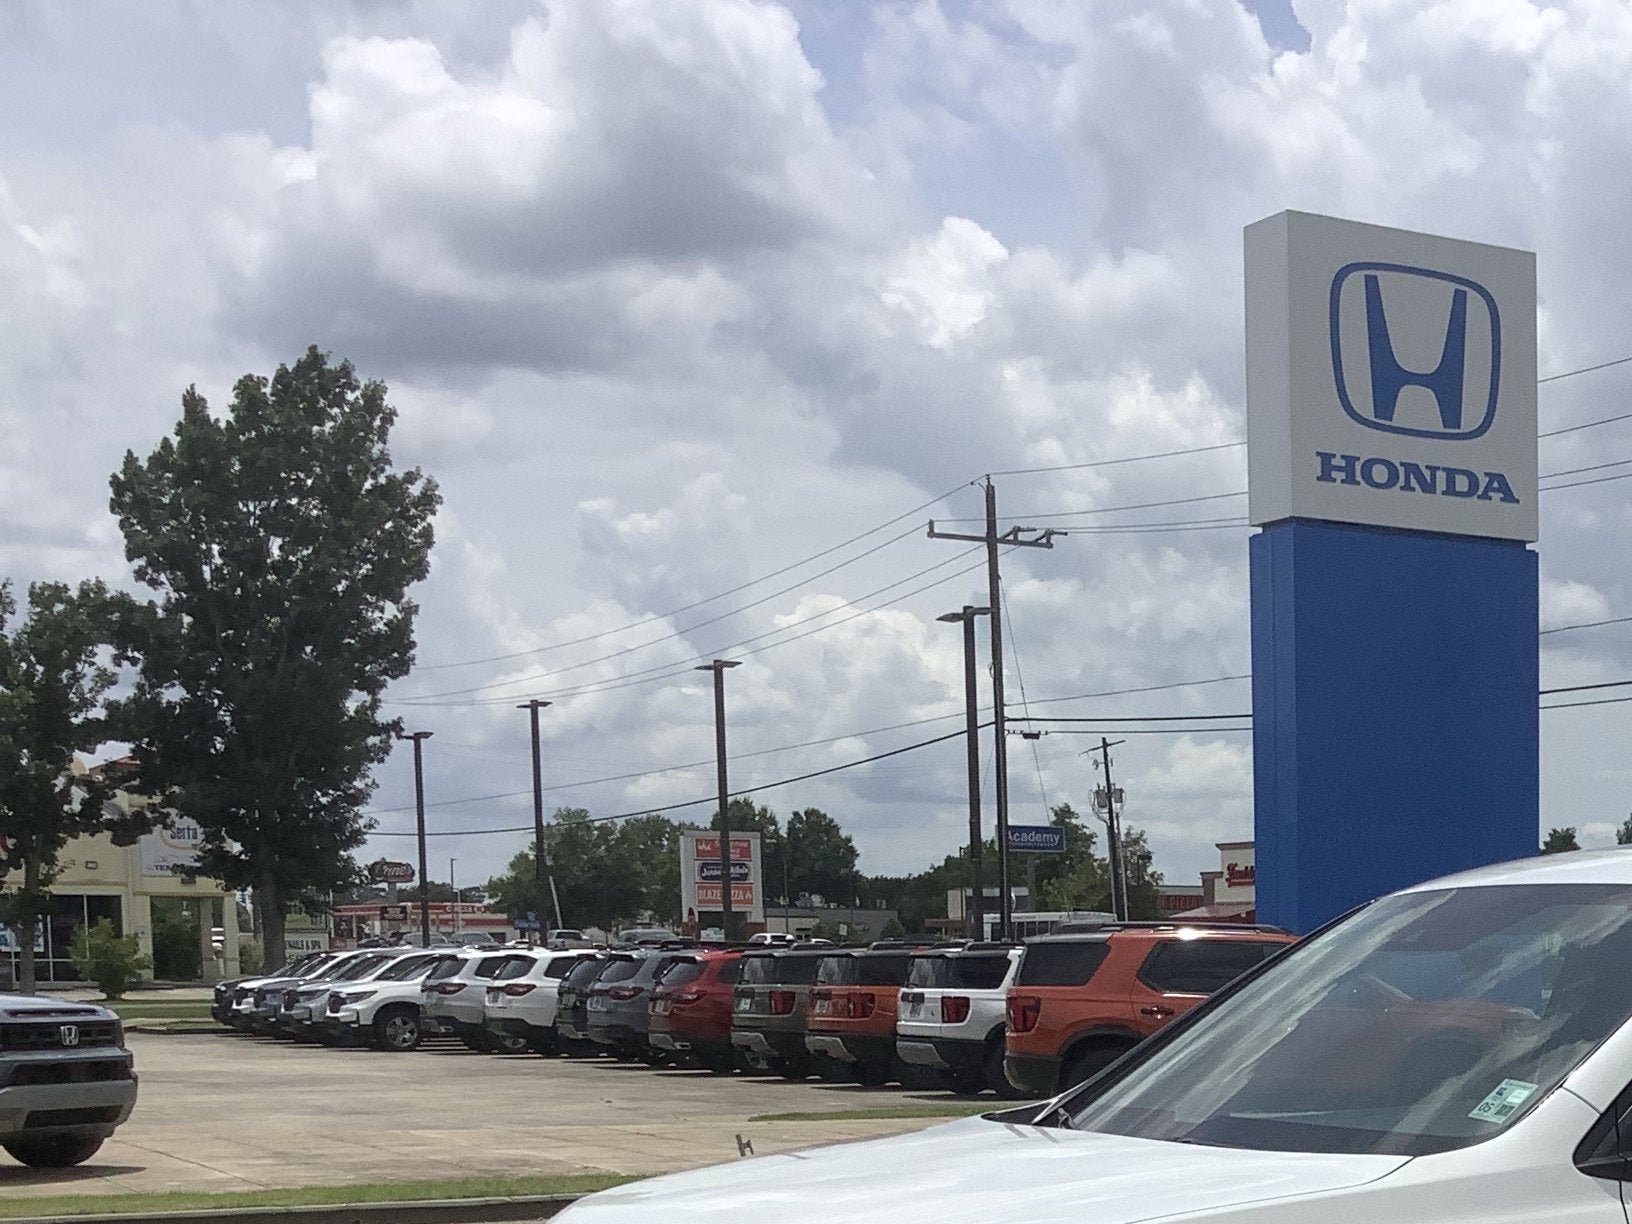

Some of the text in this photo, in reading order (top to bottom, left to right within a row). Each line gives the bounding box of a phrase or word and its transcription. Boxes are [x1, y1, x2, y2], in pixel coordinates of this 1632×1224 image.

[1315, 451, 1520, 504] HONDA
[170, 825, 198, 840] Serta
[1007, 830, 1060, 846] Academy
